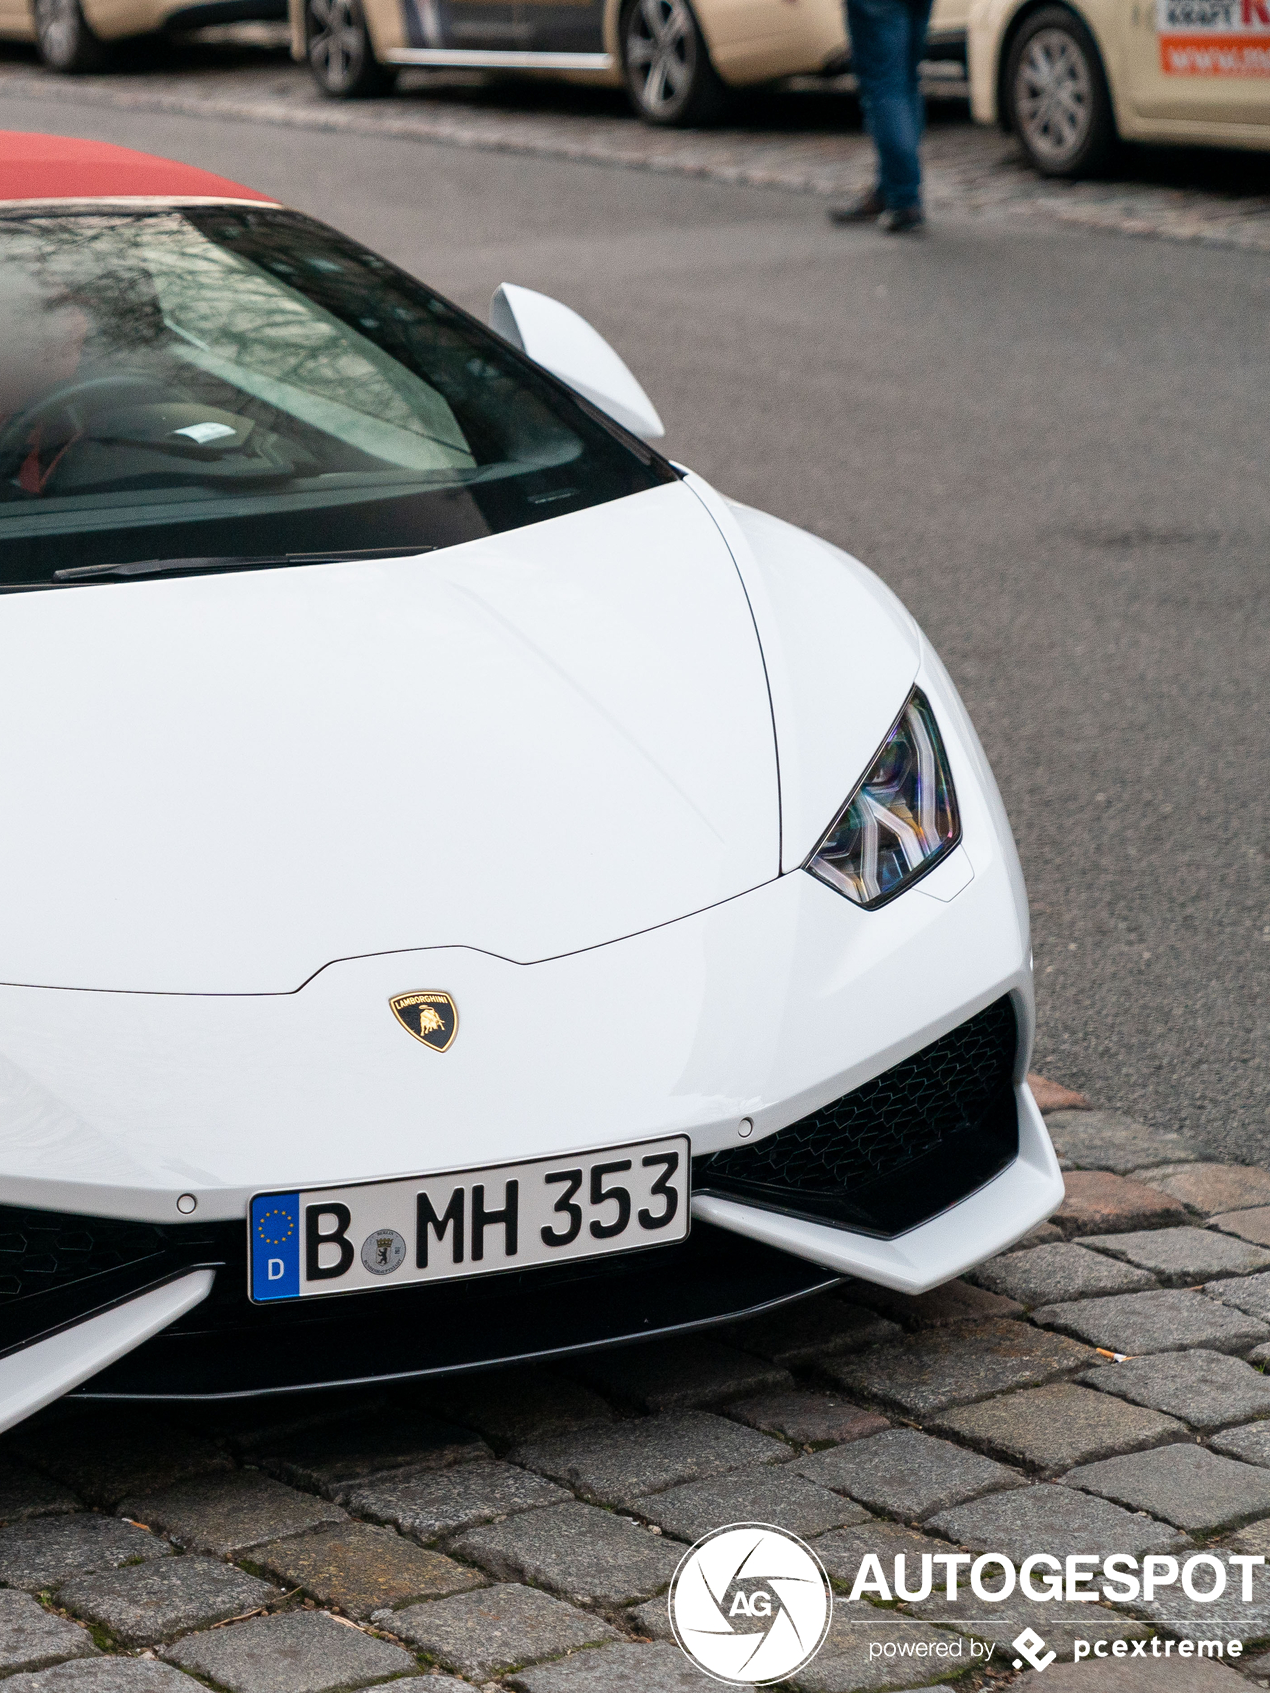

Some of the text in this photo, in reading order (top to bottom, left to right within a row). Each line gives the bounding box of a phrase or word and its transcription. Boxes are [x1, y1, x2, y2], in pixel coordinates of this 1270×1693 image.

[394, 995, 449, 1010] LAMBORGHINI
[305, 1150, 680, 1282] B MH 353
[268, 1258, 285, 1280] D
